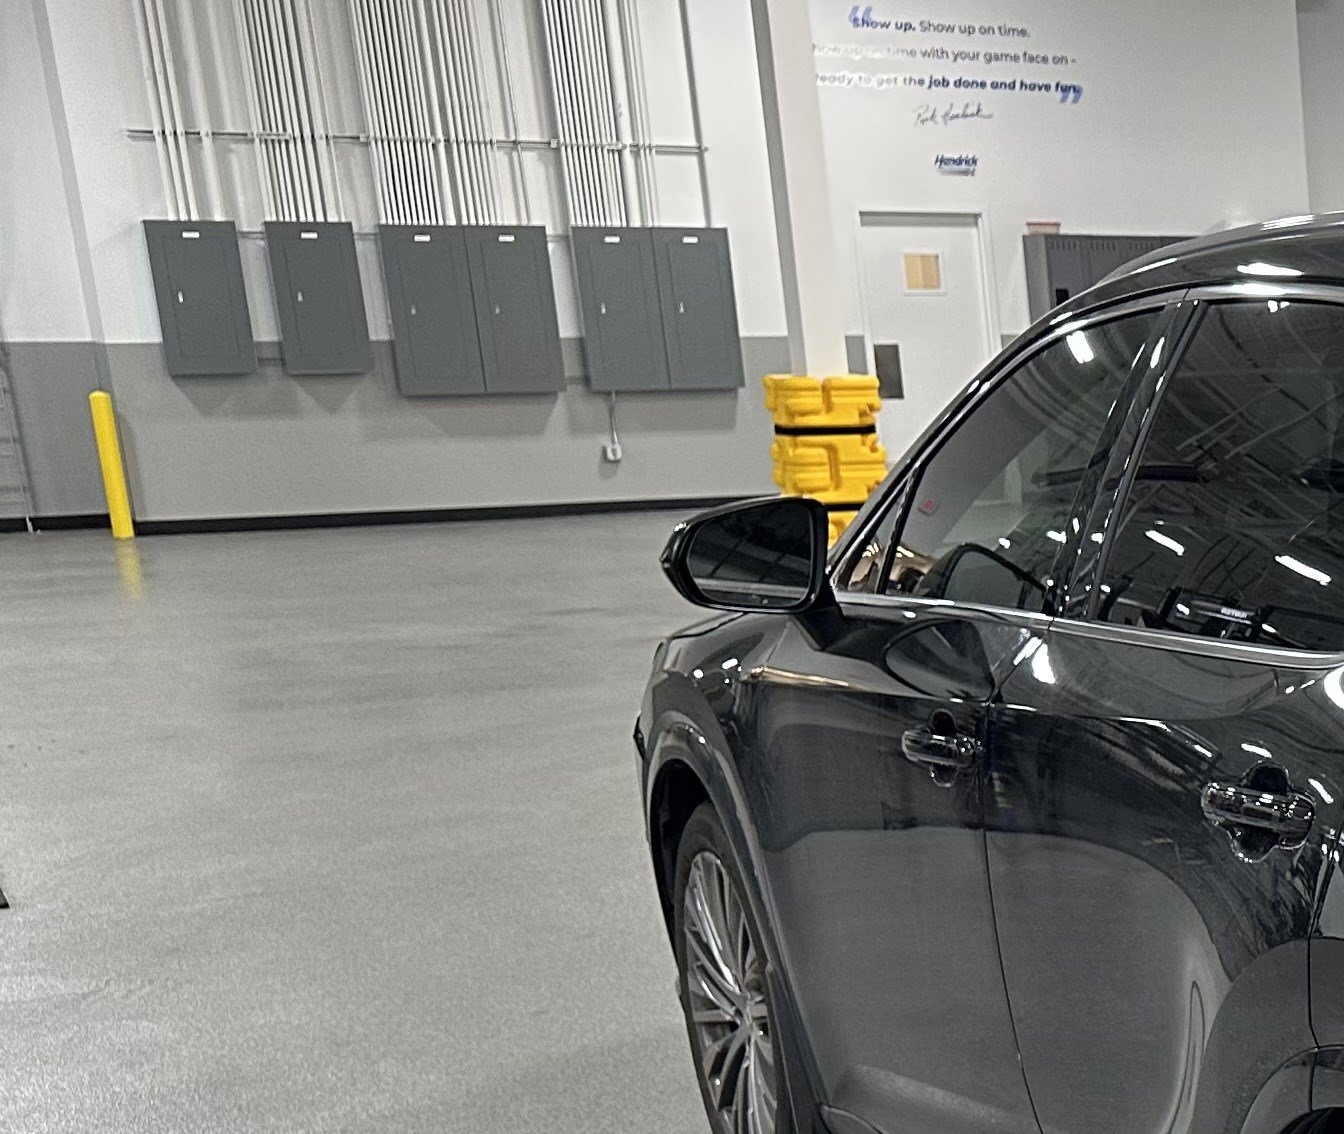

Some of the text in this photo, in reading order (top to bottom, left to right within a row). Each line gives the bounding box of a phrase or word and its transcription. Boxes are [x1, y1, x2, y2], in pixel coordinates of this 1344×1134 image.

[895, 20, 916, 33] up.
[919, 19, 955, 33] Show
[958, 23, 976, 36] up
[978, 24, 996, 36] on
[886, 46, 917, 58] time
[920, 46, 949, 60] with
[952, 49, 981, 62] your
[983, 51, 1020, 64] game
[1022, 51, 1049, 65] face
[1051, 54, 1069, 65] on
[876, 76, 898, 89] get
[903, 75, 926, 87] the
[927, 74, 950, 90] job
[953, 77, 987, 90] done
[990, 78, 1017, 91] and
[1019, 79, 1052, 92] have
